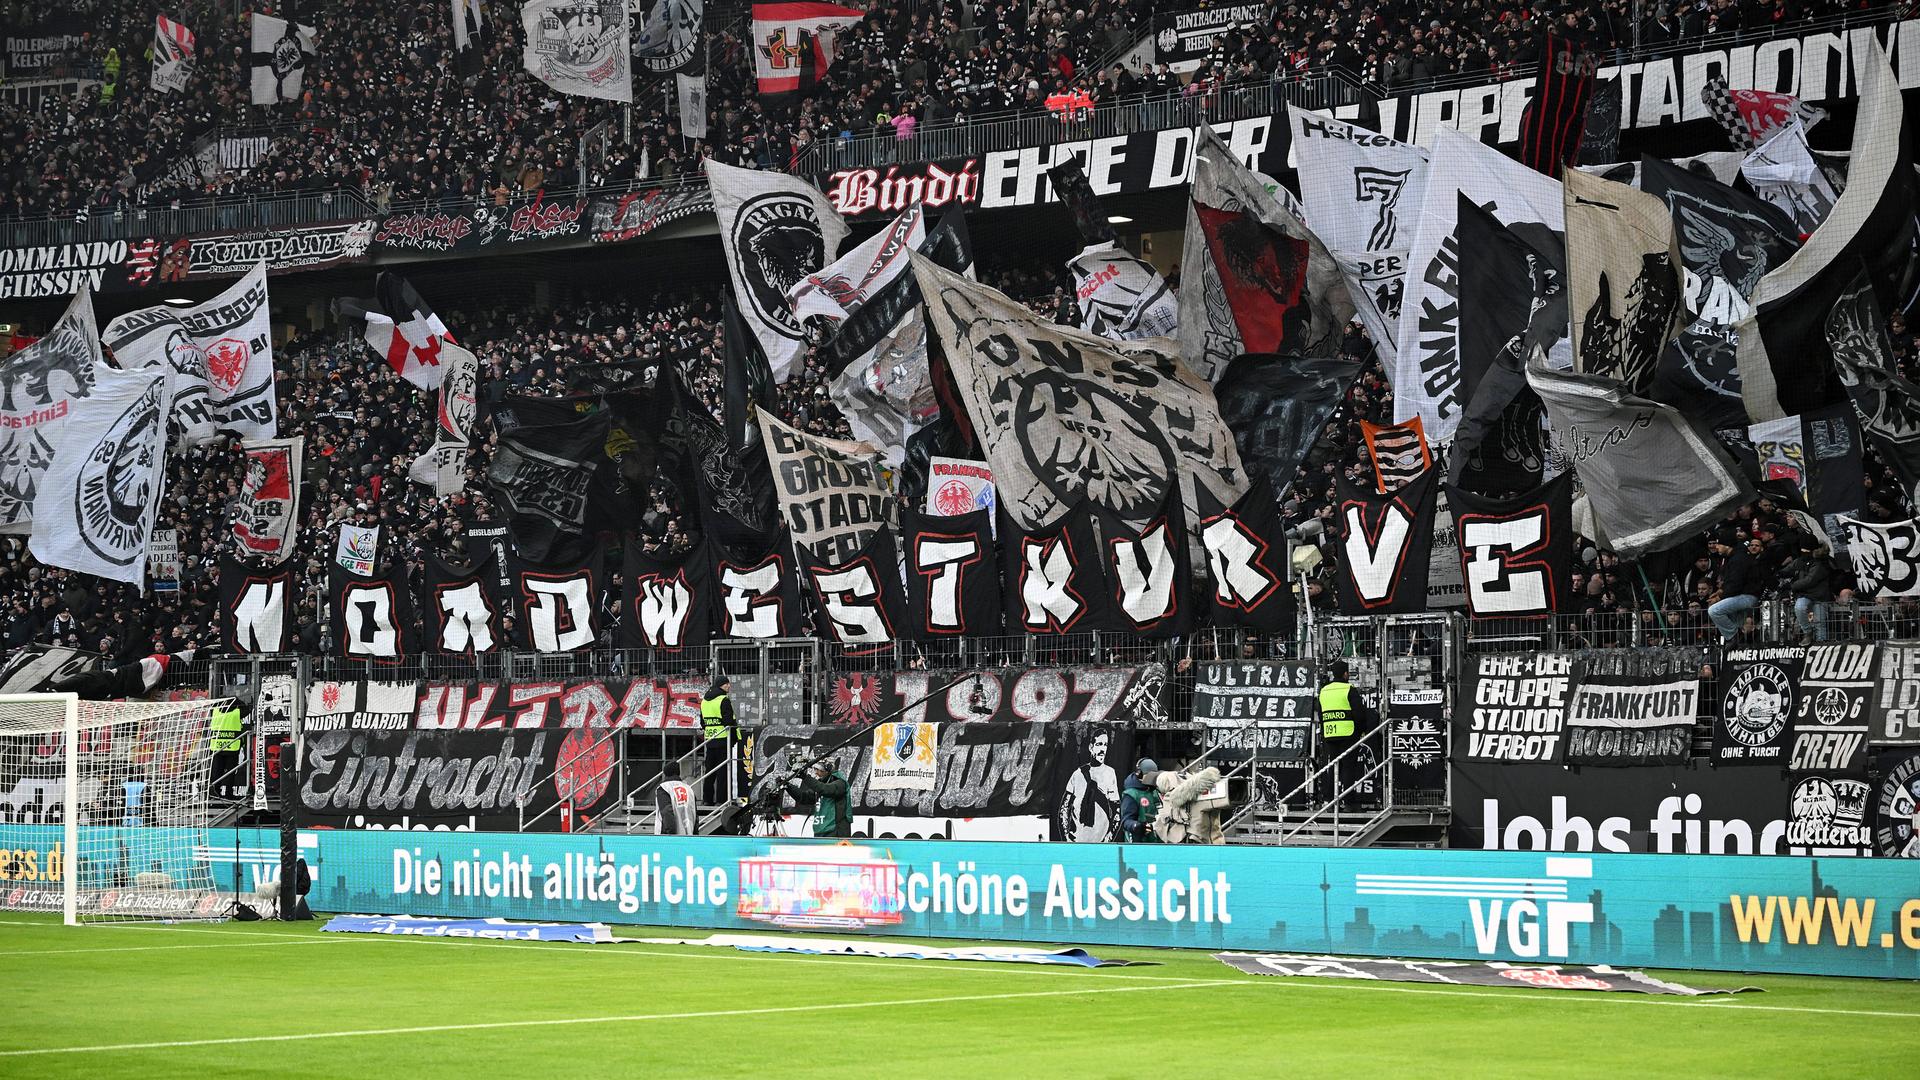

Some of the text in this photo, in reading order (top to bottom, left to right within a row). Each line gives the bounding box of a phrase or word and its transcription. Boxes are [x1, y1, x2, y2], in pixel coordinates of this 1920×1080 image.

[0, 240, 127, 273] OMMANDO
[1207, 664, 1308, 687] ULTRAS
[1800, 644, 1875, 681] FULDA
[1209, 695, 1298, 718] NEVER
[1475, 677, 1570, 708] GRUPPE
[1574, 689, 1696, 720] FRANKFURT
[1470, 707, 1565, 733] STADION
[1467, 732, 1560, 761] VERBOT
[1721, 746, 1781, 759] OHNE FURCHT
[1788, 733, 1864, 770] CREW
[301, 728, 548, 811] Eintracht
[393, 848, 443, 897] Die
[453, 852, 534, 900] nicht
[543, 850, 728, 914] alltägliche
[1043, 863, 1232, 924] Aussicht
